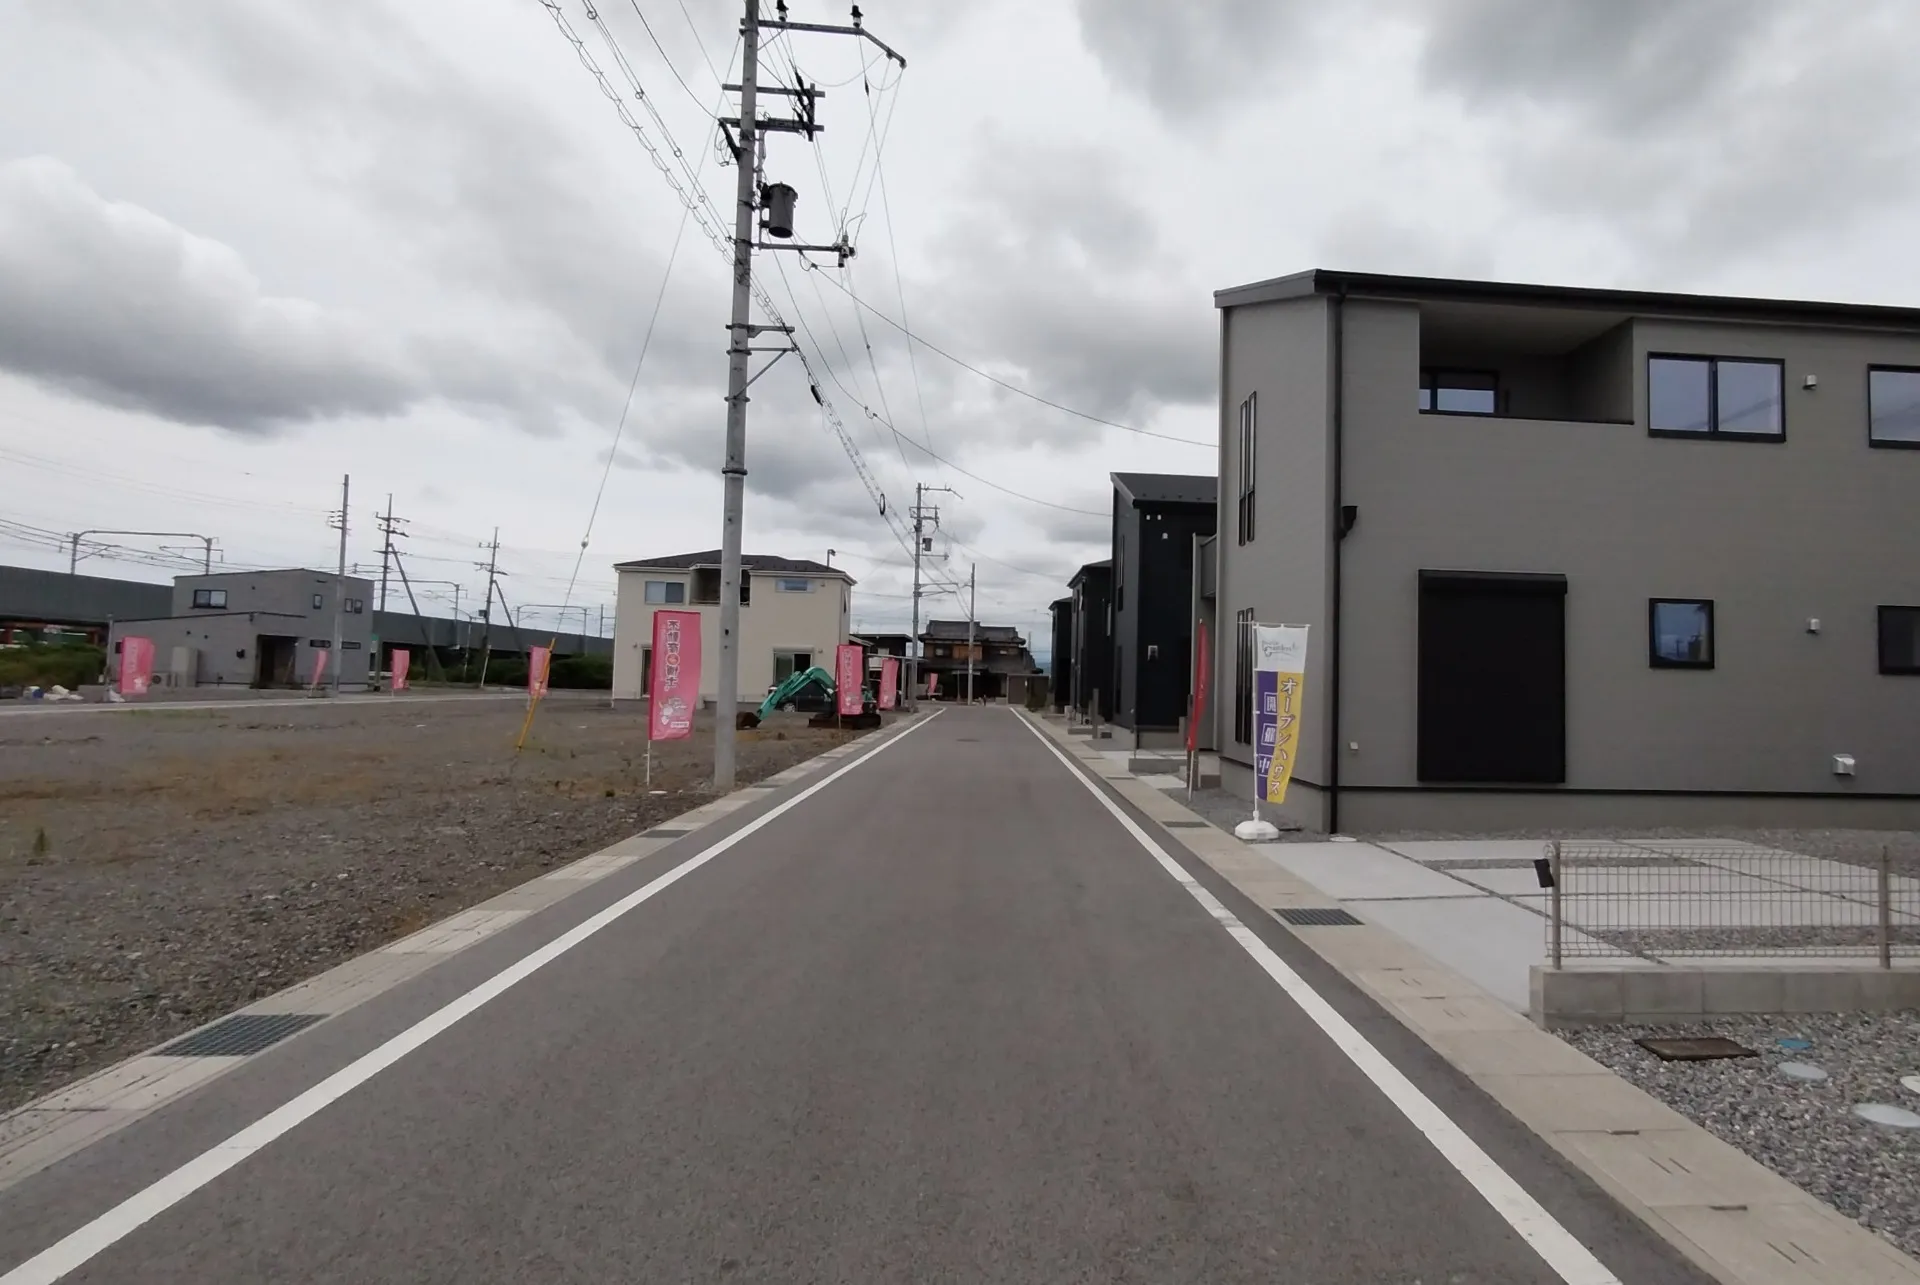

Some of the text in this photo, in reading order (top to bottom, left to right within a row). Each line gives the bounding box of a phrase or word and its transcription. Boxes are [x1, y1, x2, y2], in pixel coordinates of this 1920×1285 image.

[1270, 678, 1298, 795] オープンハウス
